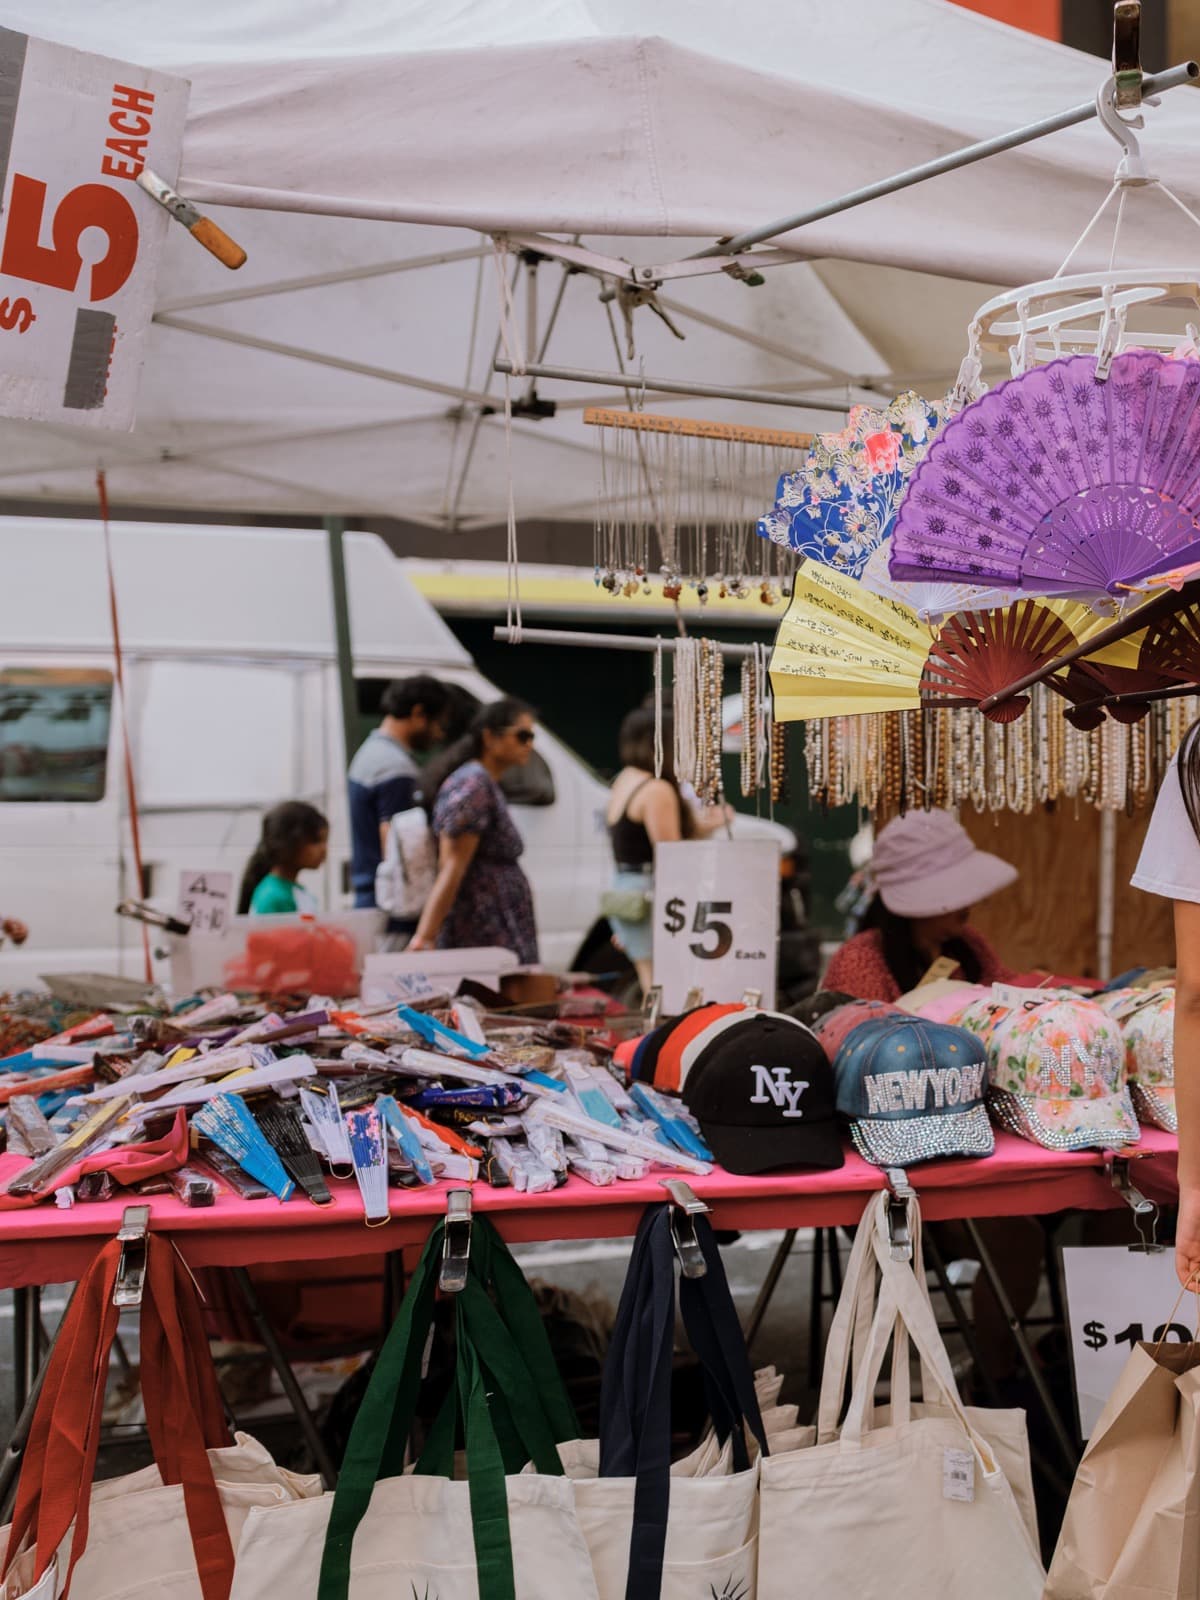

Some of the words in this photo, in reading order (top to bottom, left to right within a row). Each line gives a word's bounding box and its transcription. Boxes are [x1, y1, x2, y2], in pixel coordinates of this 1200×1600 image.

[101, 84, 155, 181] EACH
[663, 897, 734, 961] $5
[735, 950, 766, 960] Each
[750, 1064, 810, 1118] NY
